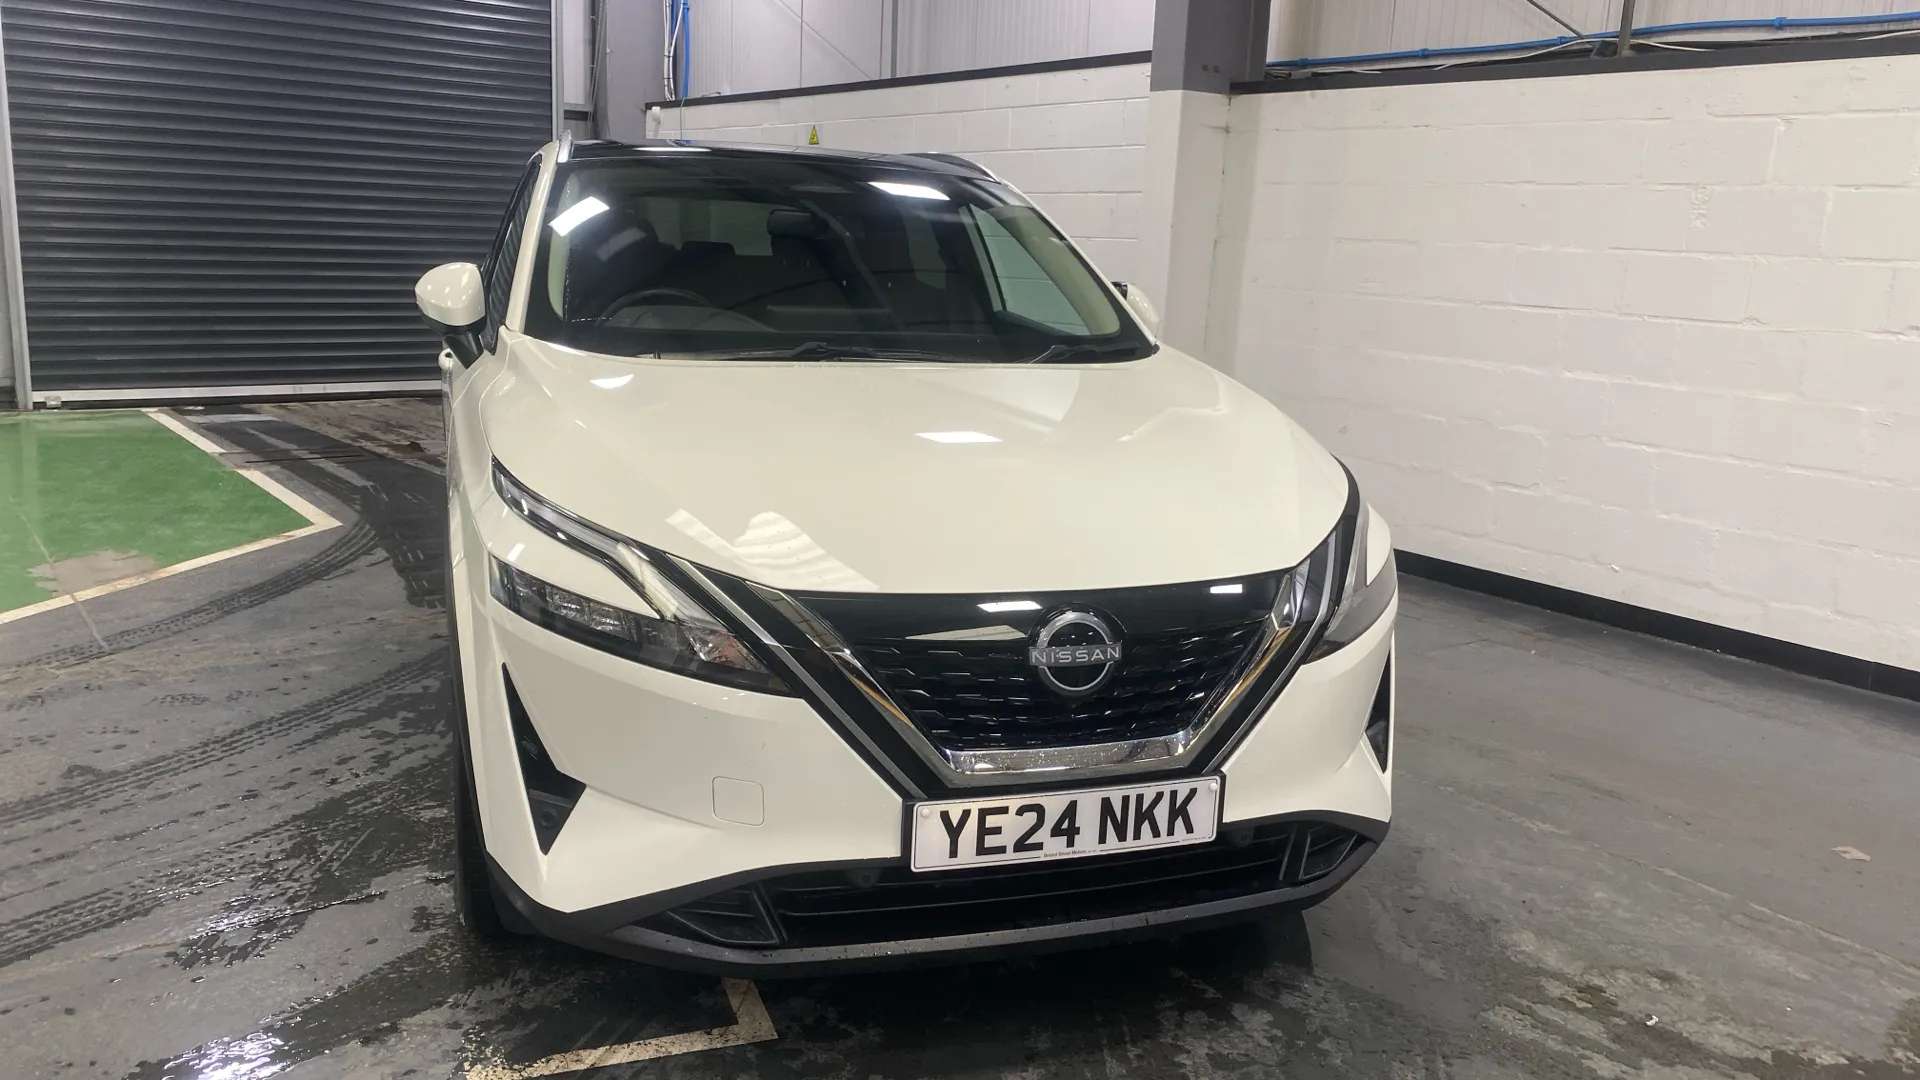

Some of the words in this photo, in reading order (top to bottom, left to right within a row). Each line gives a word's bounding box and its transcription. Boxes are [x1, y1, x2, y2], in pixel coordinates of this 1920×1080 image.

[1031, 647, 1120, 663] NISSAN
[939, 800, 1080, 858] YE24
[1098, 787, 1198, 844] NKK
